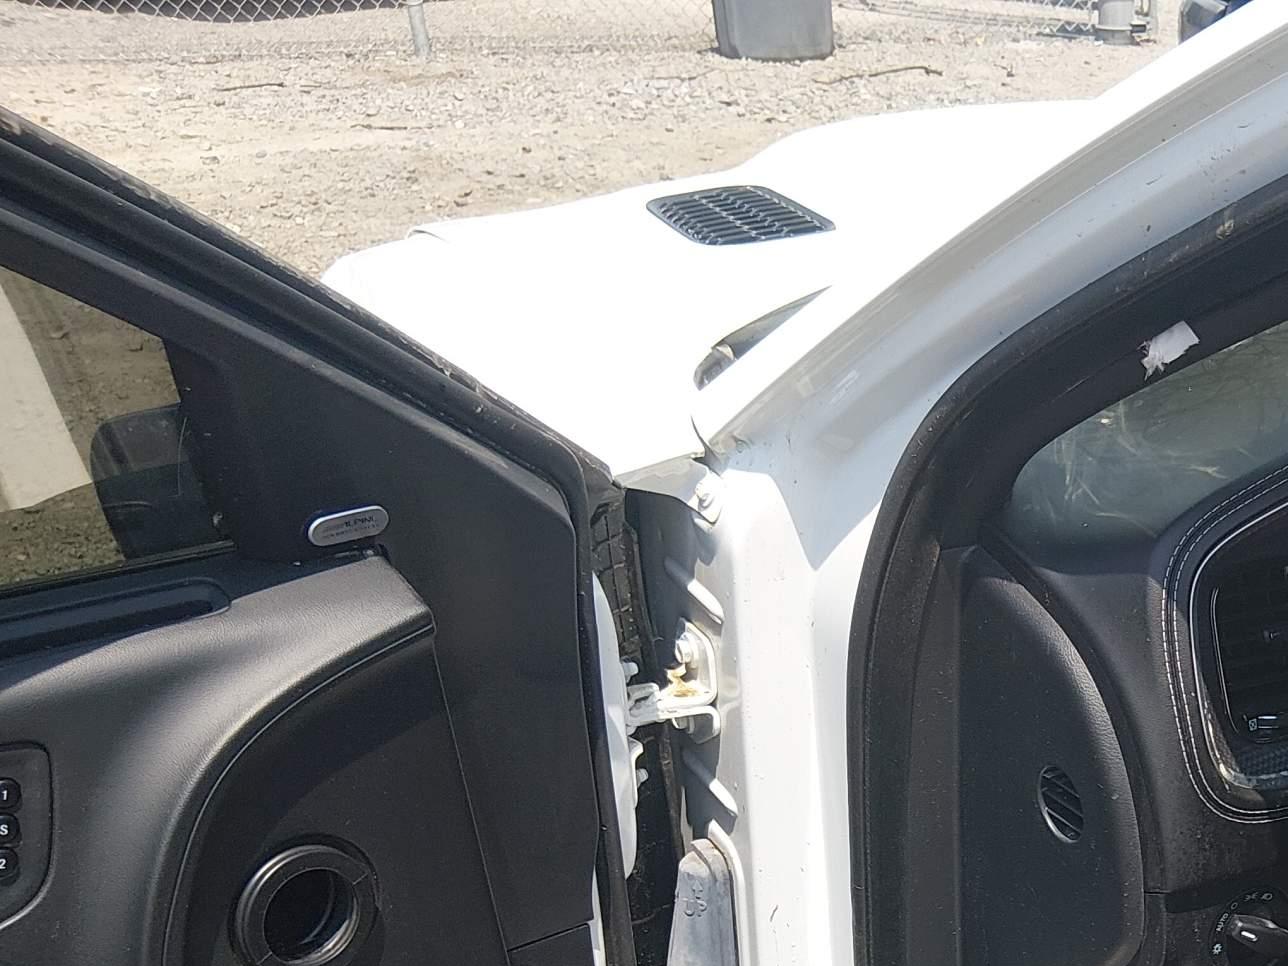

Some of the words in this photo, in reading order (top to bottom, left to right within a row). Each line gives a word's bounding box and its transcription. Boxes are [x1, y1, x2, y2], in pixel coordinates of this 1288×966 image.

[1, 789, 8, 801] 1
[0, 823, 9, 836] S
[0, 858, 7, 870] 2
[1215, 912, 1229, 932] AUTO
